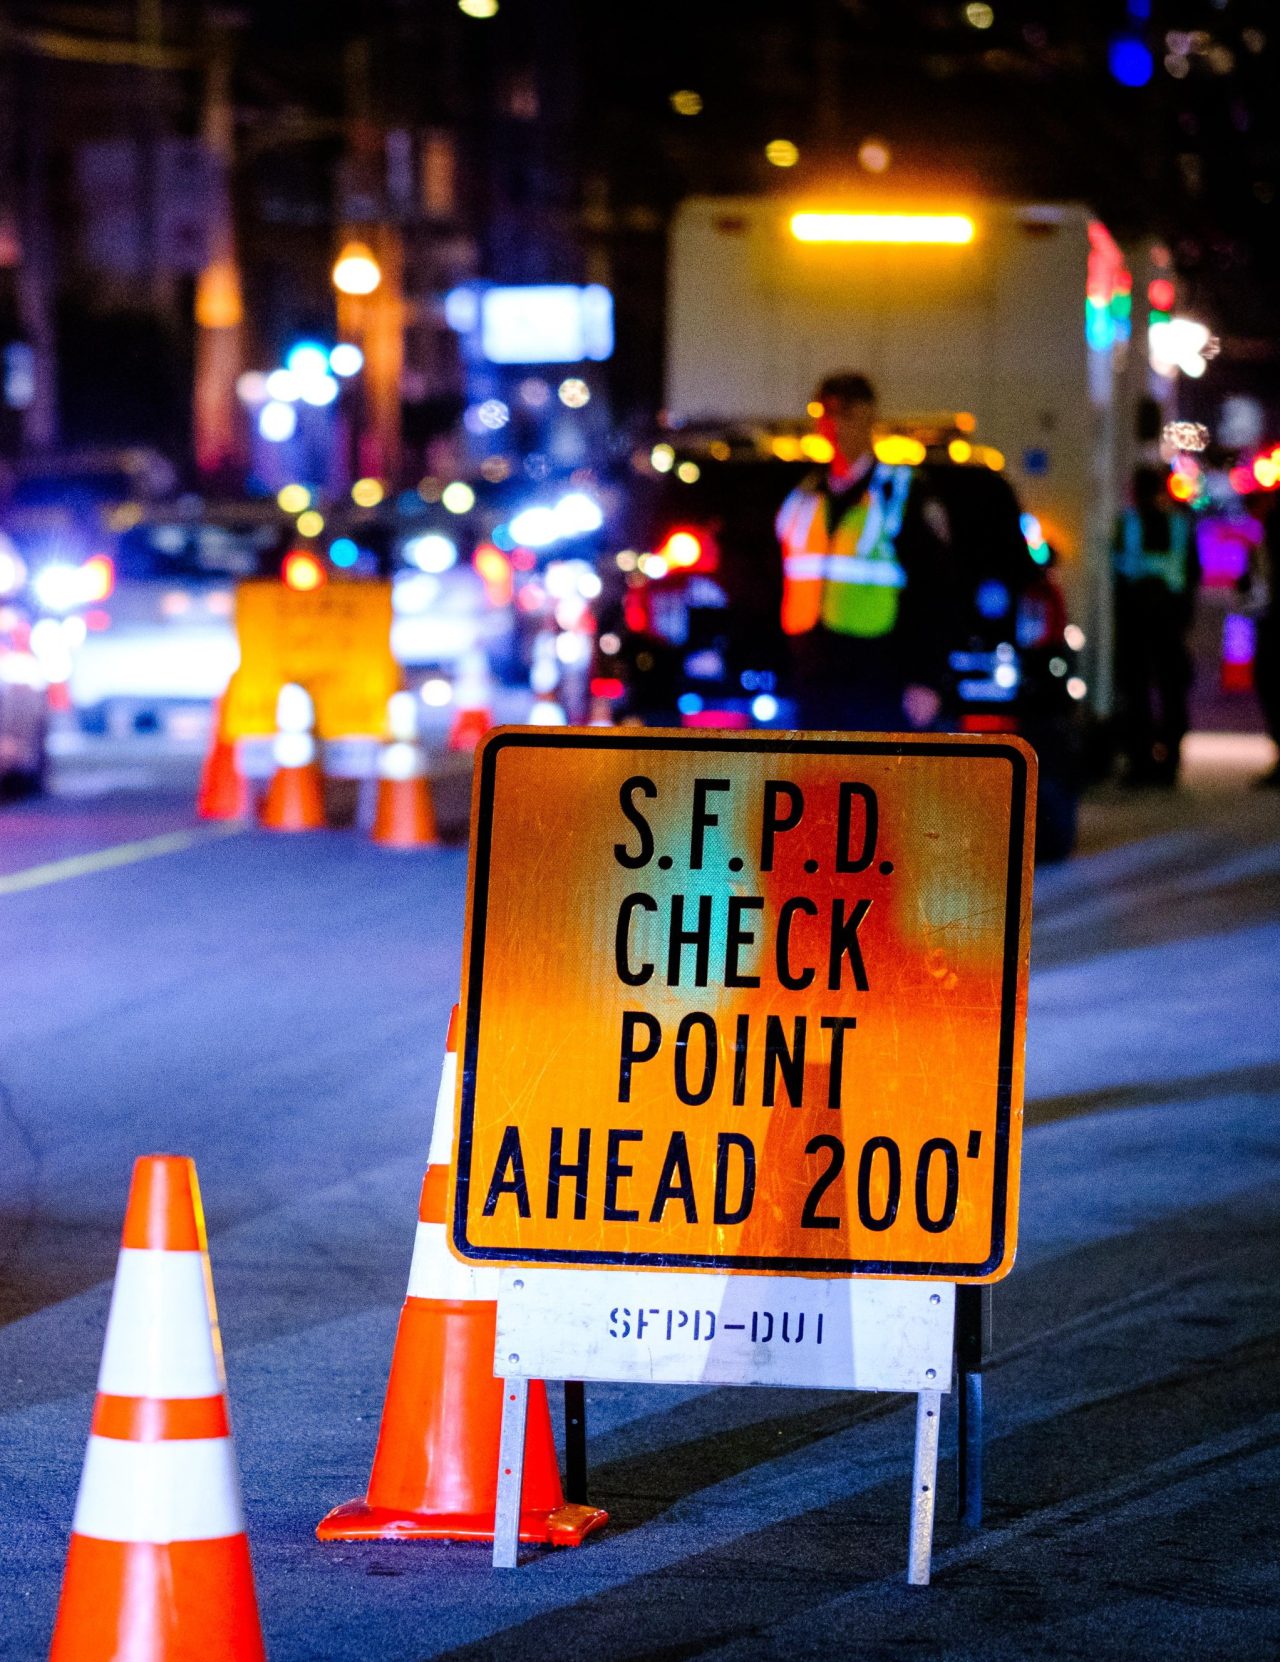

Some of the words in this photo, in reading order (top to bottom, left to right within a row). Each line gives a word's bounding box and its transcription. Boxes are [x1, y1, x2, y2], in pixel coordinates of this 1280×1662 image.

[614, 776, 895, 874] S.F.P.D.
[615, 892, 872, 991] CHECK
[617, 1011, 857, 1110] POINT
[482, 1126, 756, 1226] AHEAD
[801, 1130, 982, 1233] 200'
[609, 1307, 823, 1344] SFPD-DUI
